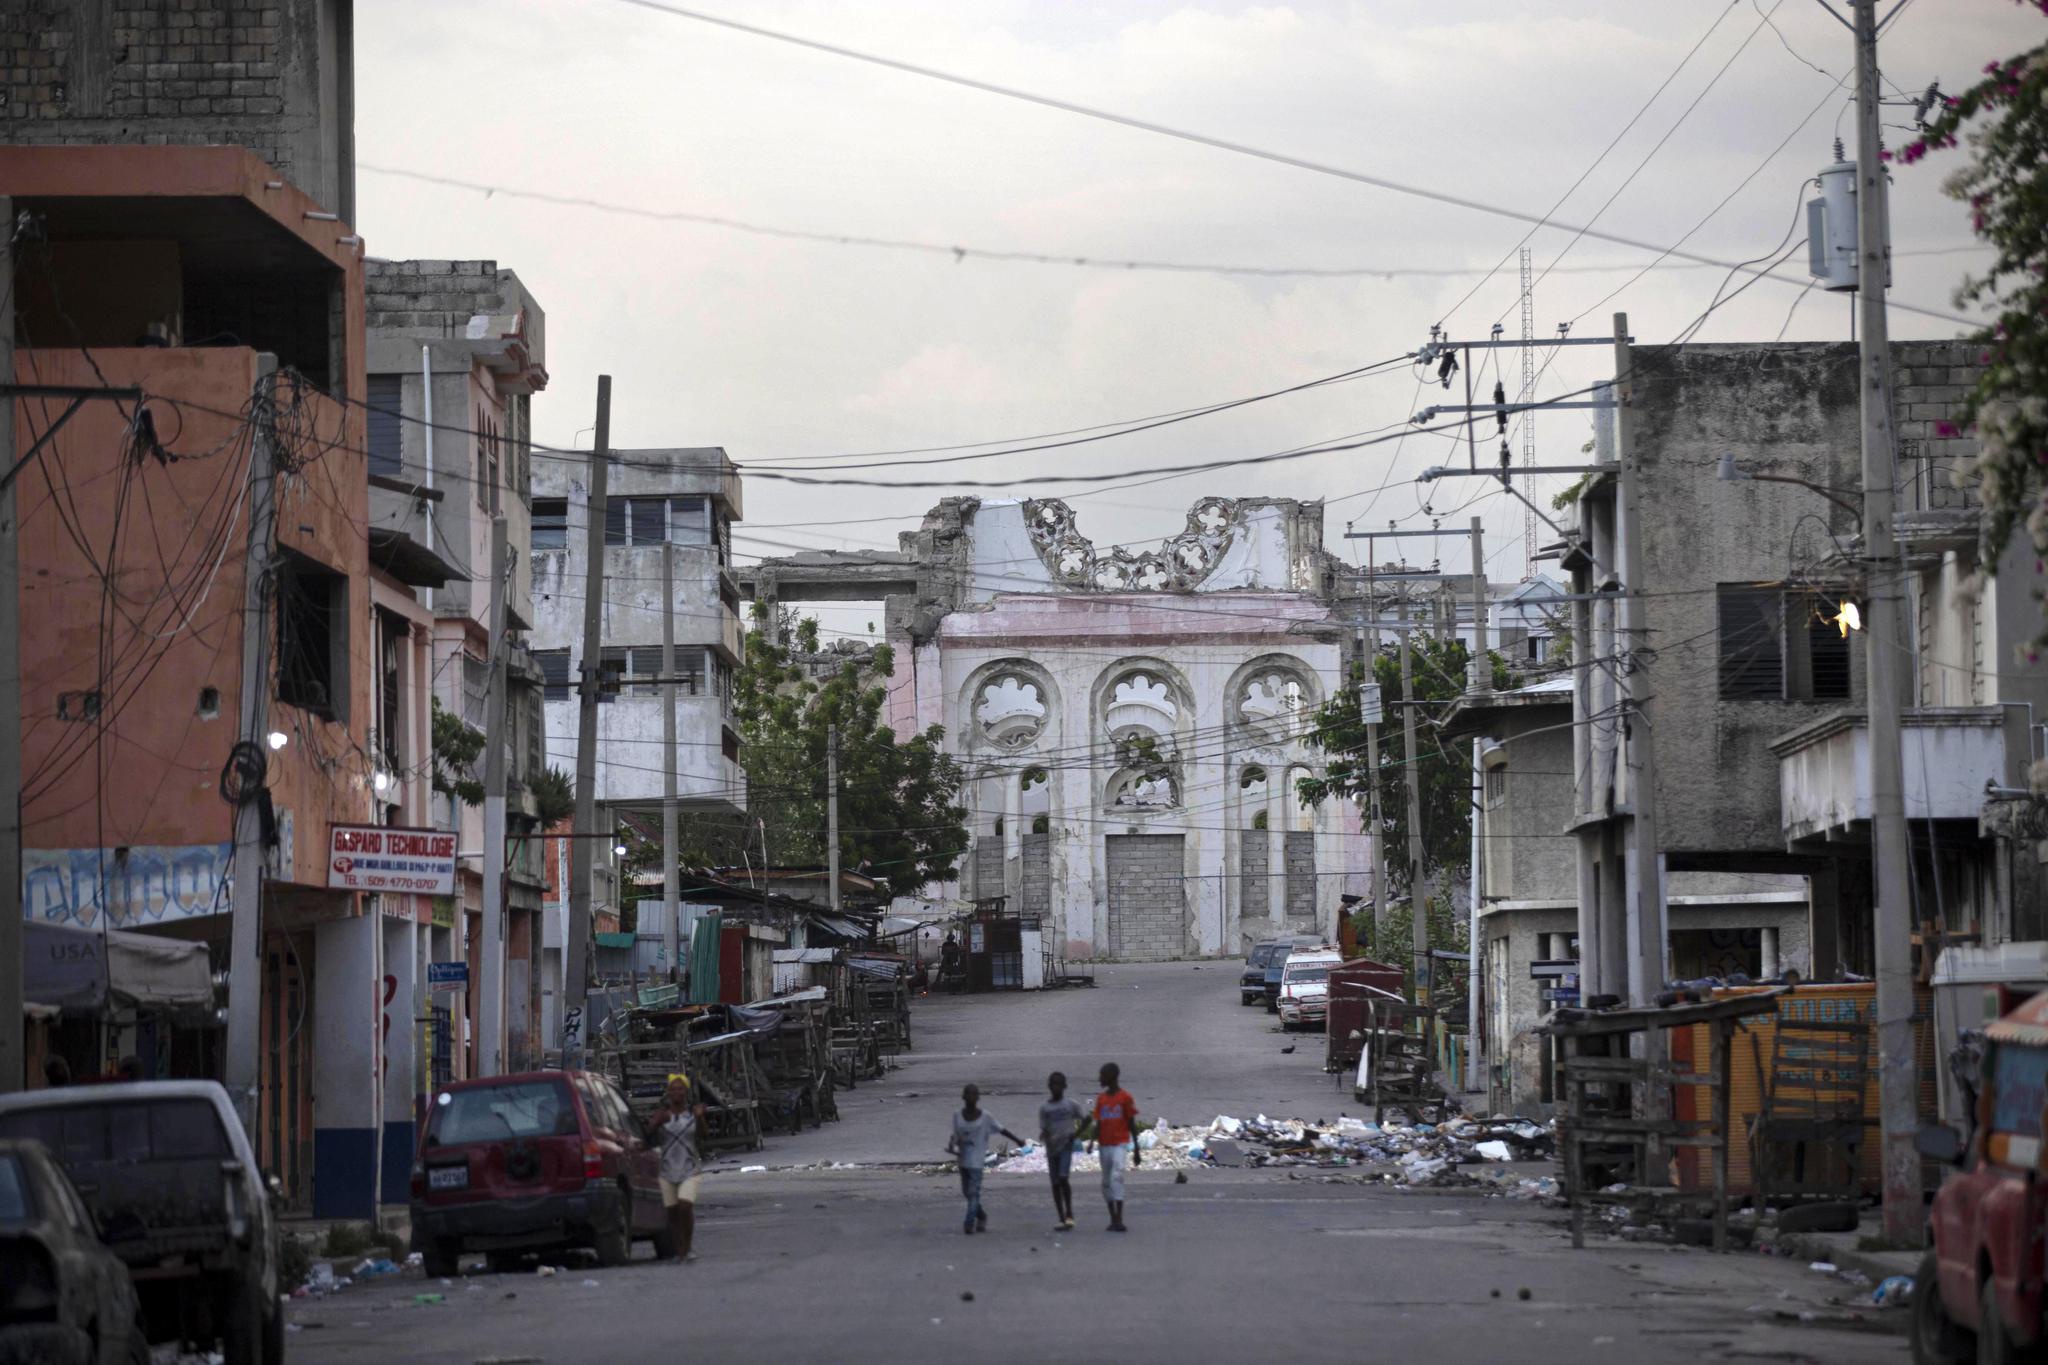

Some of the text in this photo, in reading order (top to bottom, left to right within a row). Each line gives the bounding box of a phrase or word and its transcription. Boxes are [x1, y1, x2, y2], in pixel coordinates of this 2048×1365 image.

[334, 831, 454, 857] GASPARD TECHNOLOGIE
[50, 943, 96, 961] USA
